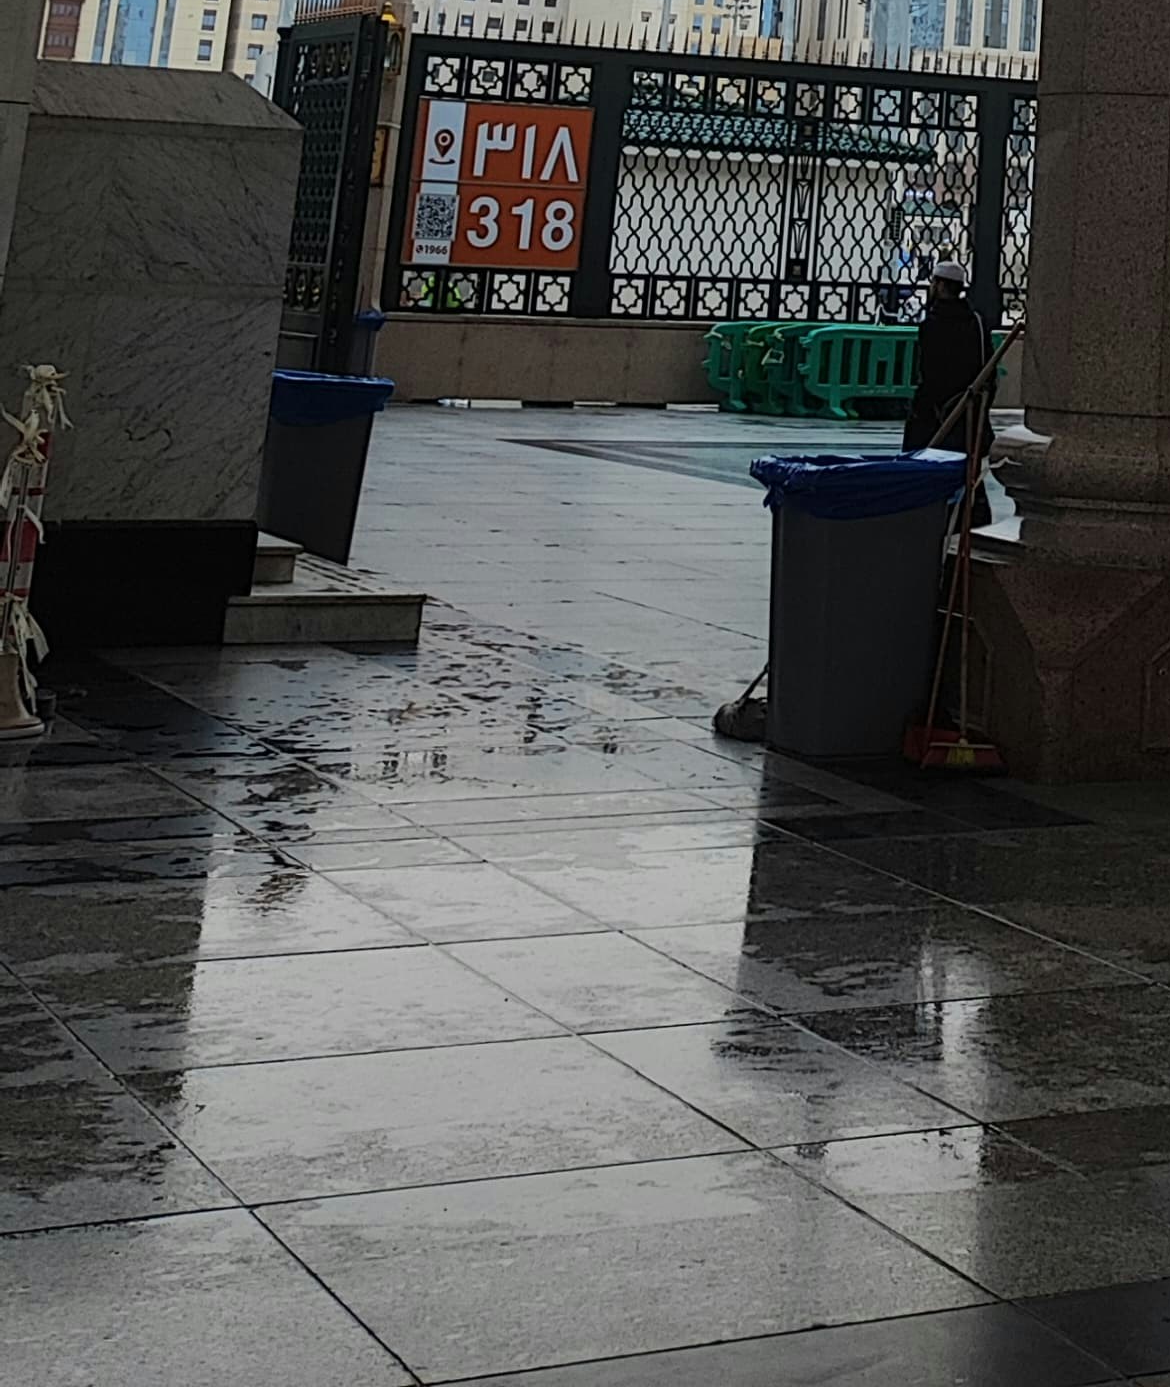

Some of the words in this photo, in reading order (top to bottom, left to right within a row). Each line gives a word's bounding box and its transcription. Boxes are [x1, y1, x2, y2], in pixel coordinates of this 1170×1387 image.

[473, 122, 579, 183] ٣١٨
[424, 244, 448, 255] 1966
[466, 195, 575, 251] 318
